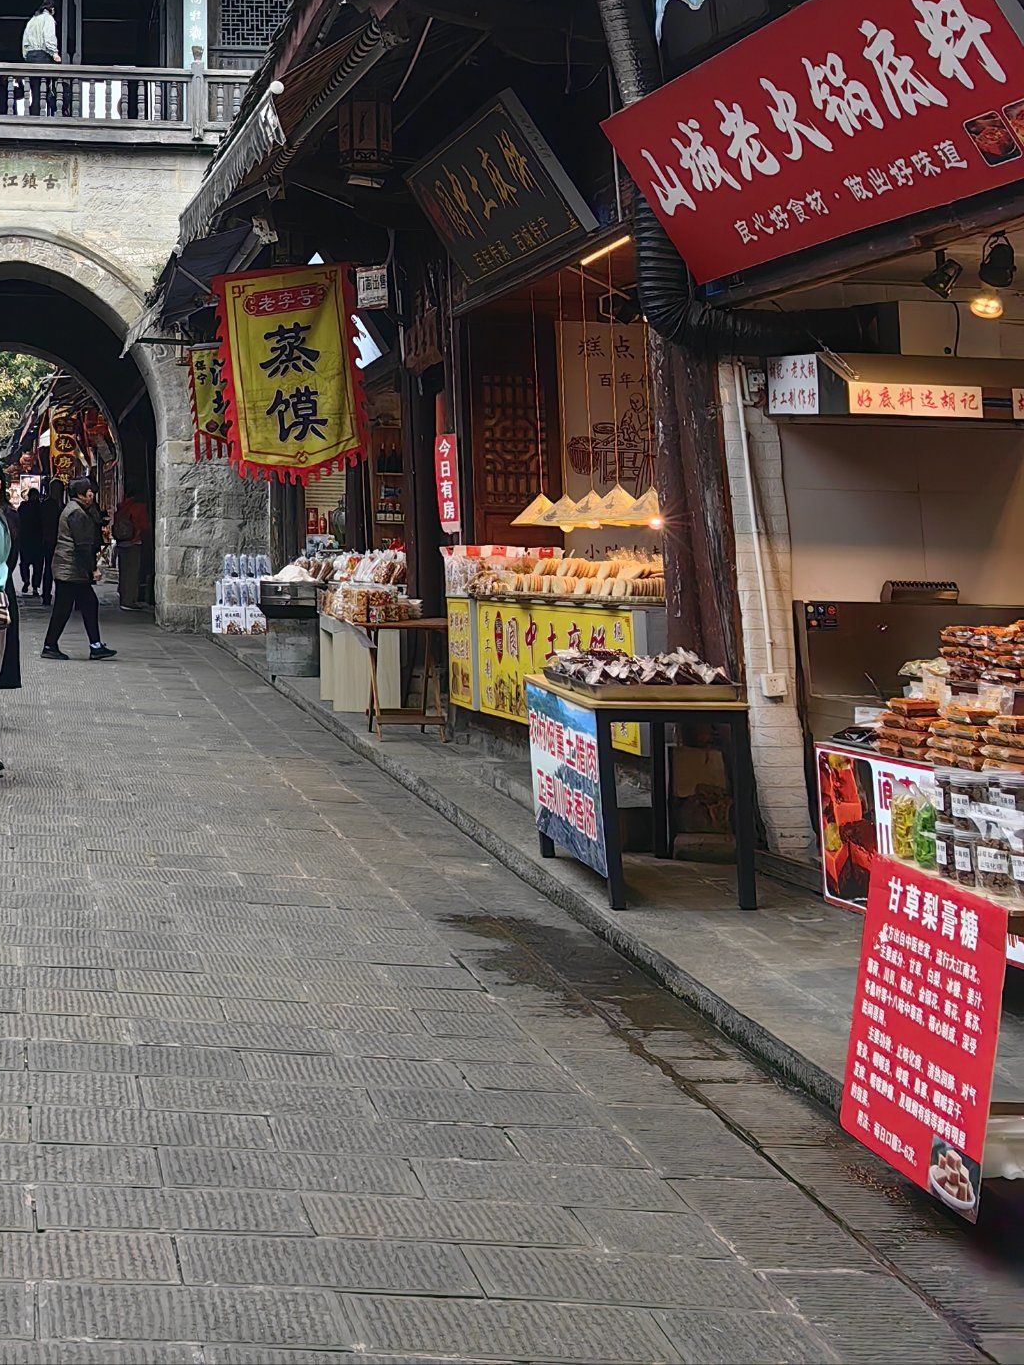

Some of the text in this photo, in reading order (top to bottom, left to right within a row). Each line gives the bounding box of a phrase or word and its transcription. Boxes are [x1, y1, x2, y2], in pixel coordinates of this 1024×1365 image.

[258, 290, 315, 313] 老字号
[577, 335, 635, 358] 糕点
[259, 321, 328, 443] 蒸馍
[857, 387, 979, 411] 好底料选胡记
[437, 438, 457, 520] 今日有房
[888, 875, 980, 953] 甘草梨膏糖
